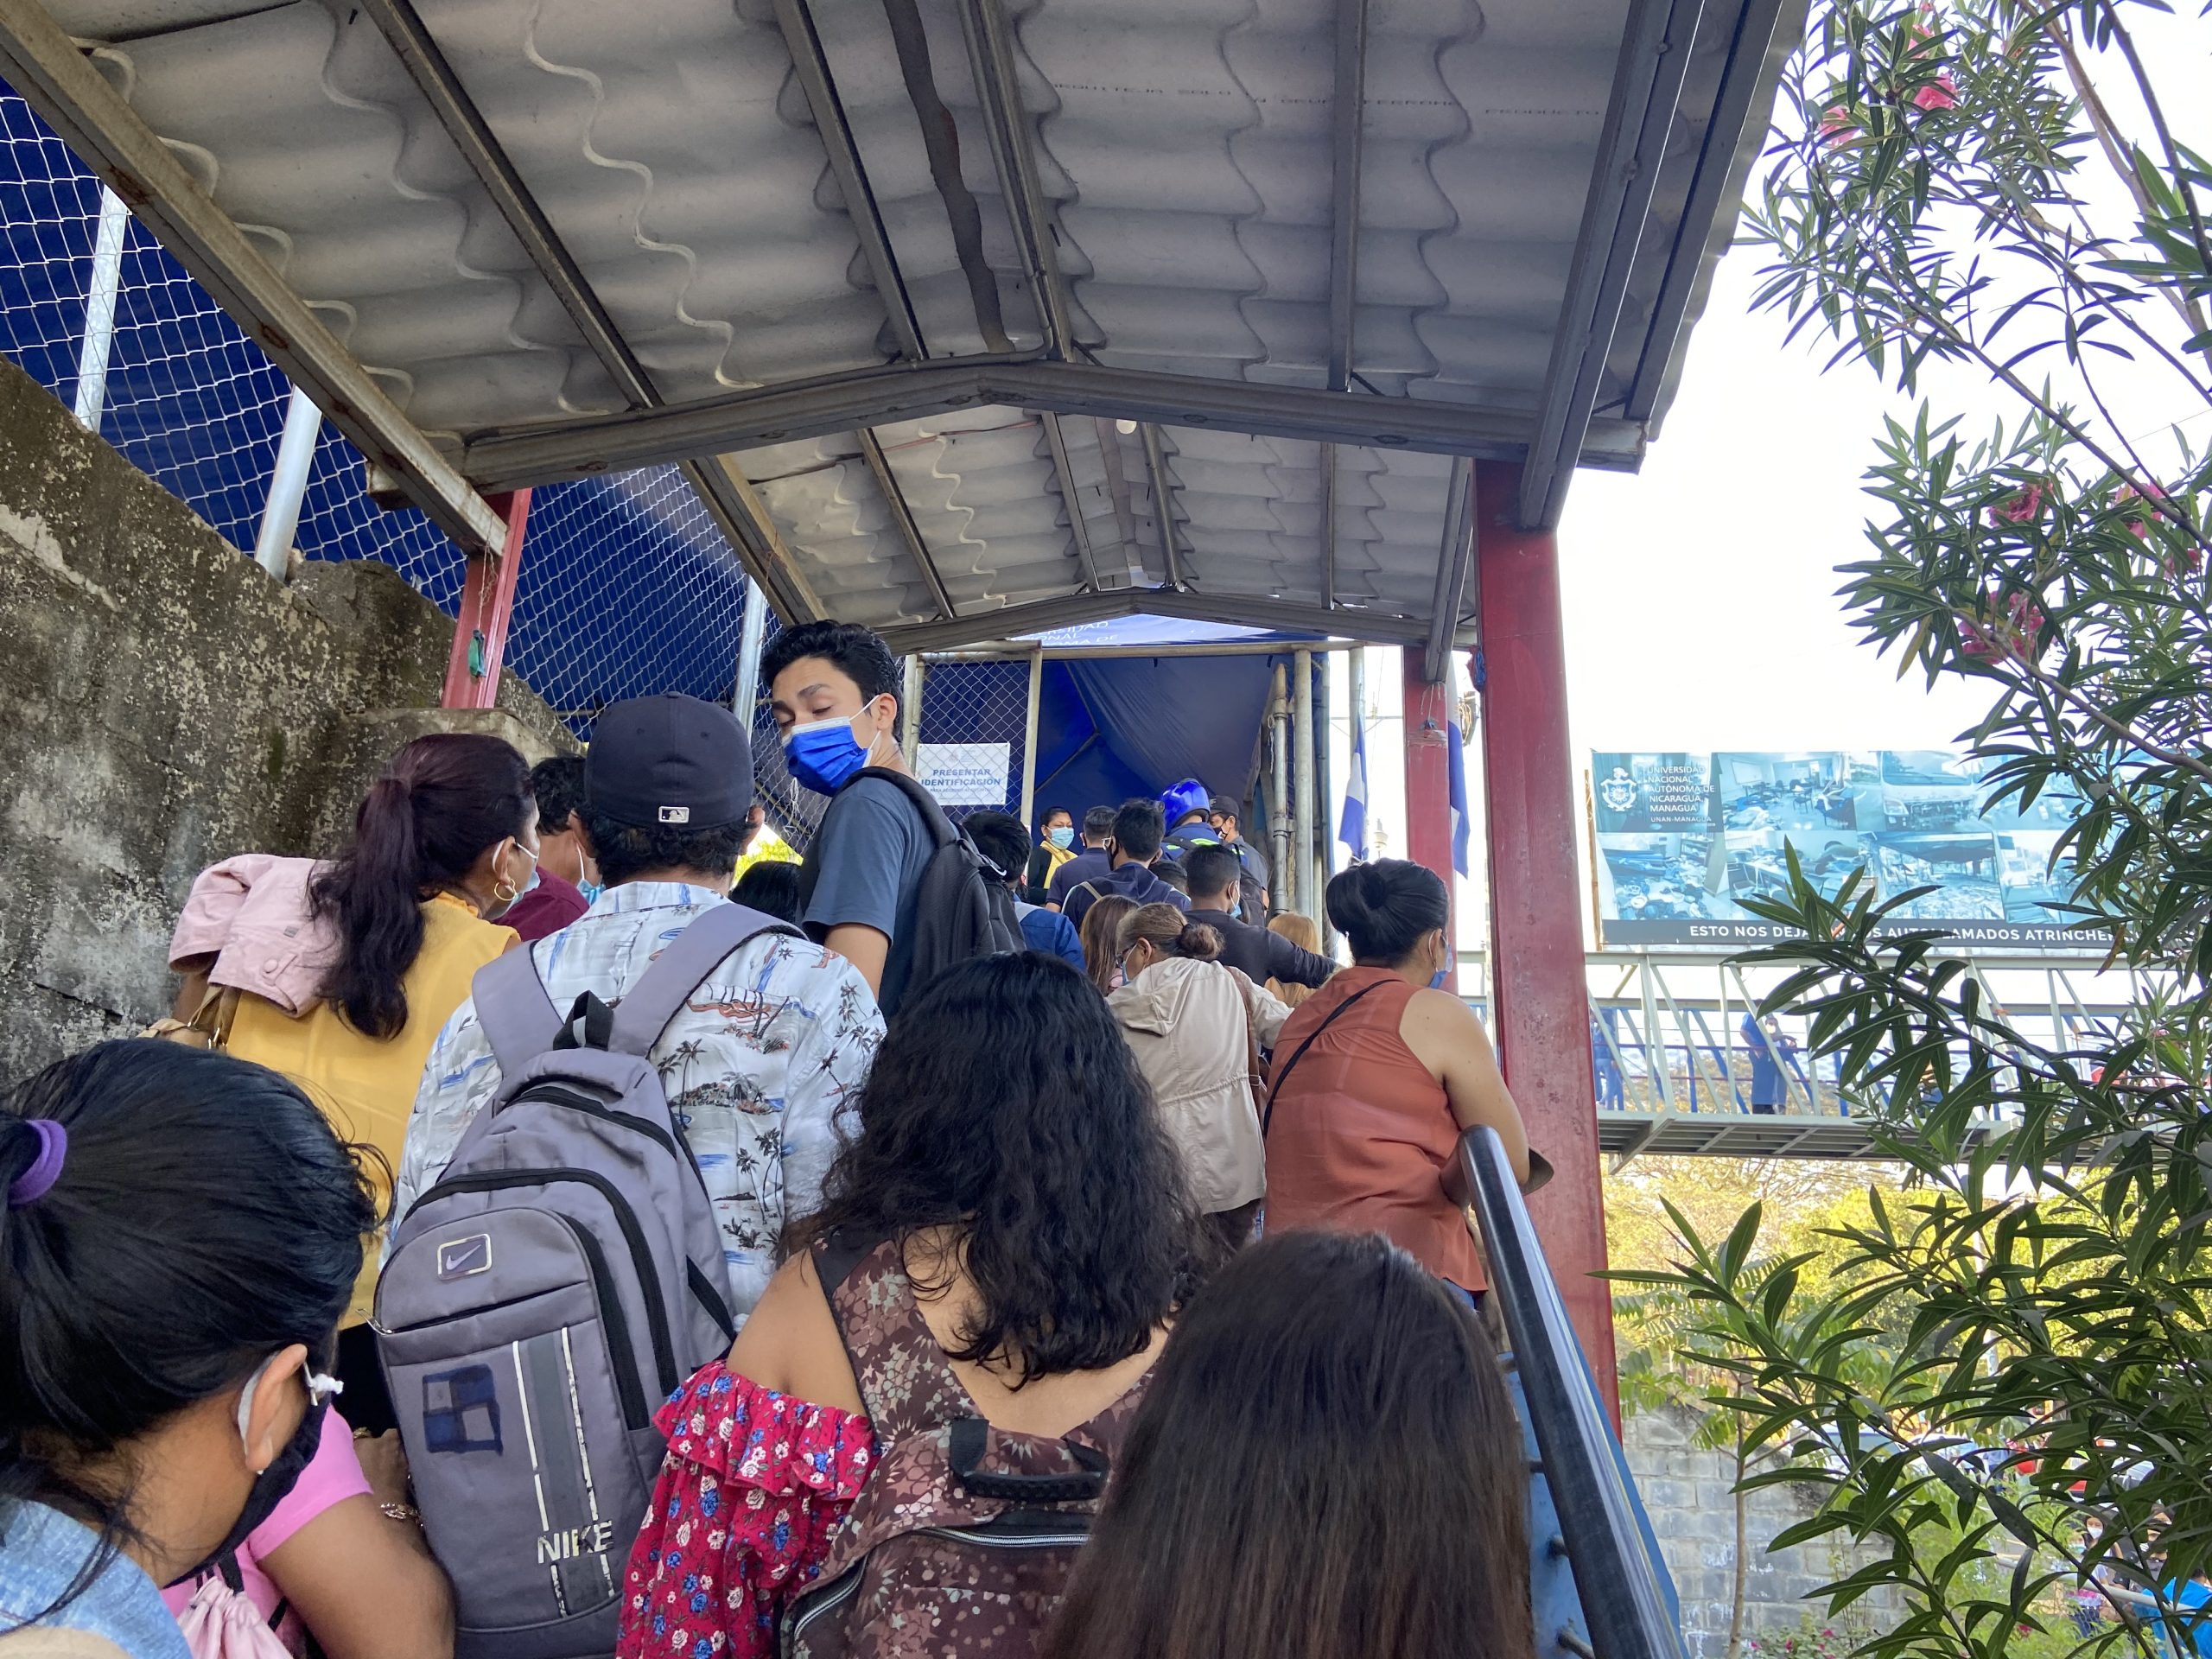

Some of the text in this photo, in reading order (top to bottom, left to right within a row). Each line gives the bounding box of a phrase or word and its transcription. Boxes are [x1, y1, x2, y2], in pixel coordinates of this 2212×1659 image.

[1647, 766, 1707, 774] UNIVERSIDAD
[1690, 925, 1730, 937] ESTO
[1734, 926, 1768, 938] NOS
[537, 1520, 614, 1564] NIKE
